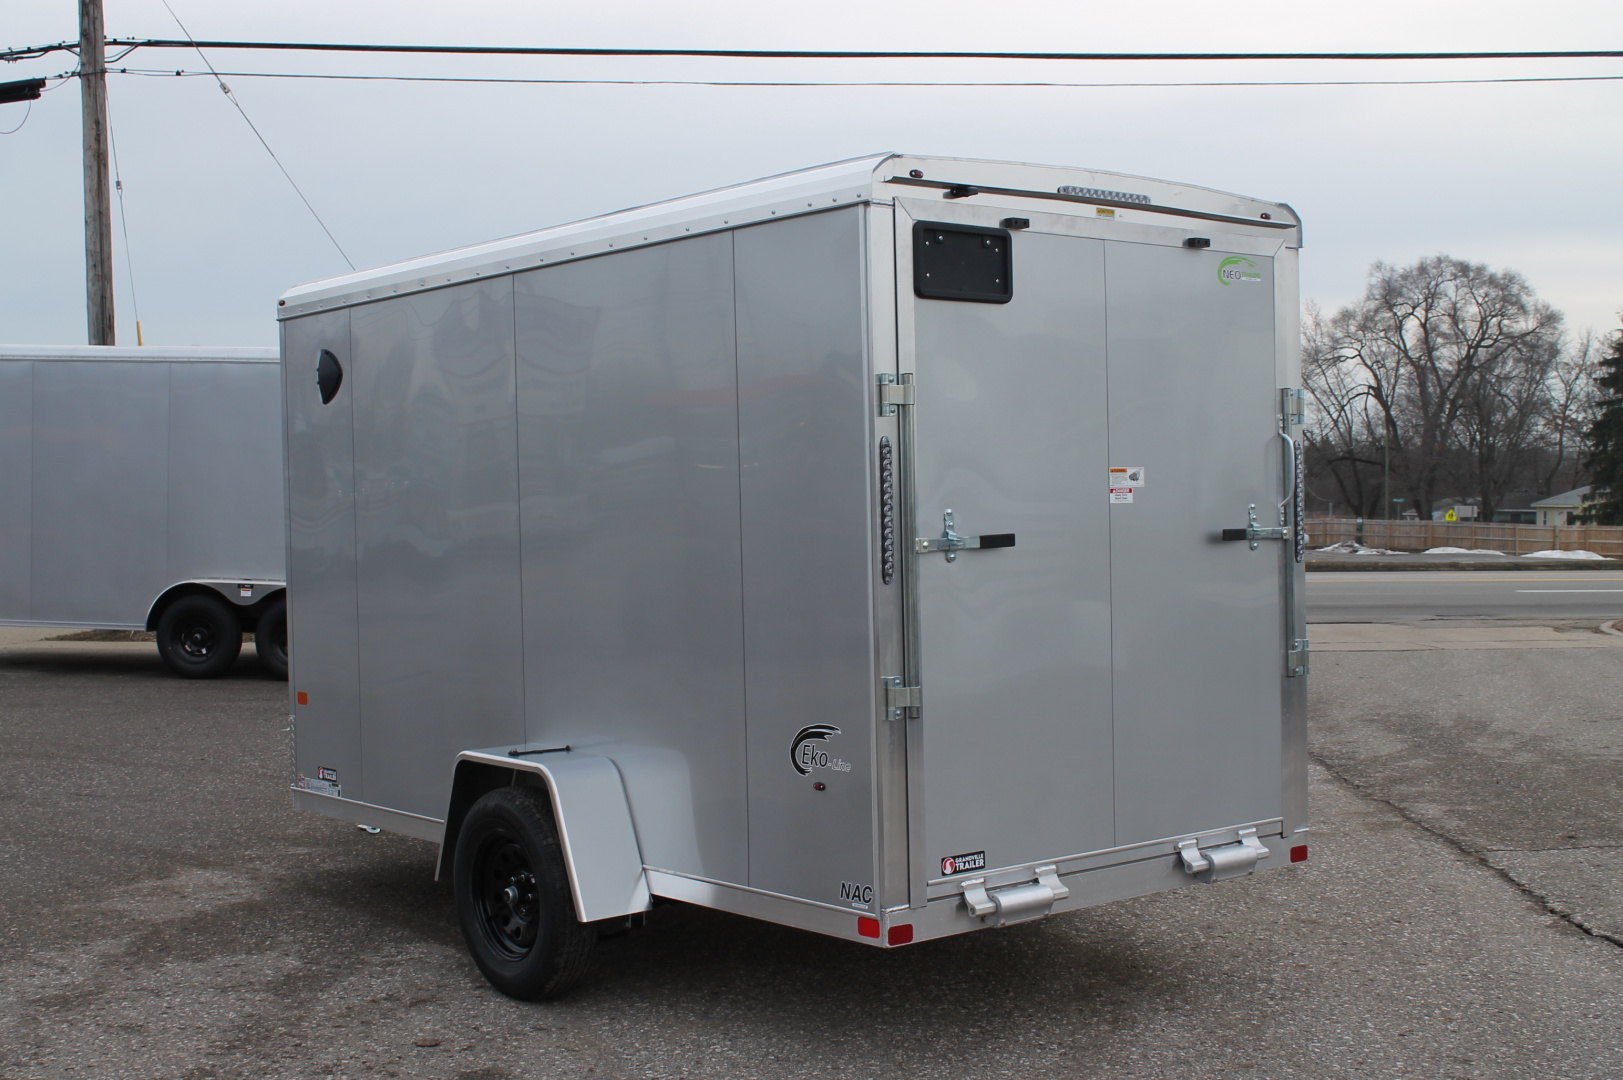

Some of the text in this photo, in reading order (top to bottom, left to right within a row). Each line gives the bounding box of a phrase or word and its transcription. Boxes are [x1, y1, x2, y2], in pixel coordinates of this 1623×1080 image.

[1222, 269, 1241, 280] NEO
[955, 853, 984, 863] GRANDVILLE
[955, 859, 984, 871] TRAILER
[840, 881, 873, 904] NAC
